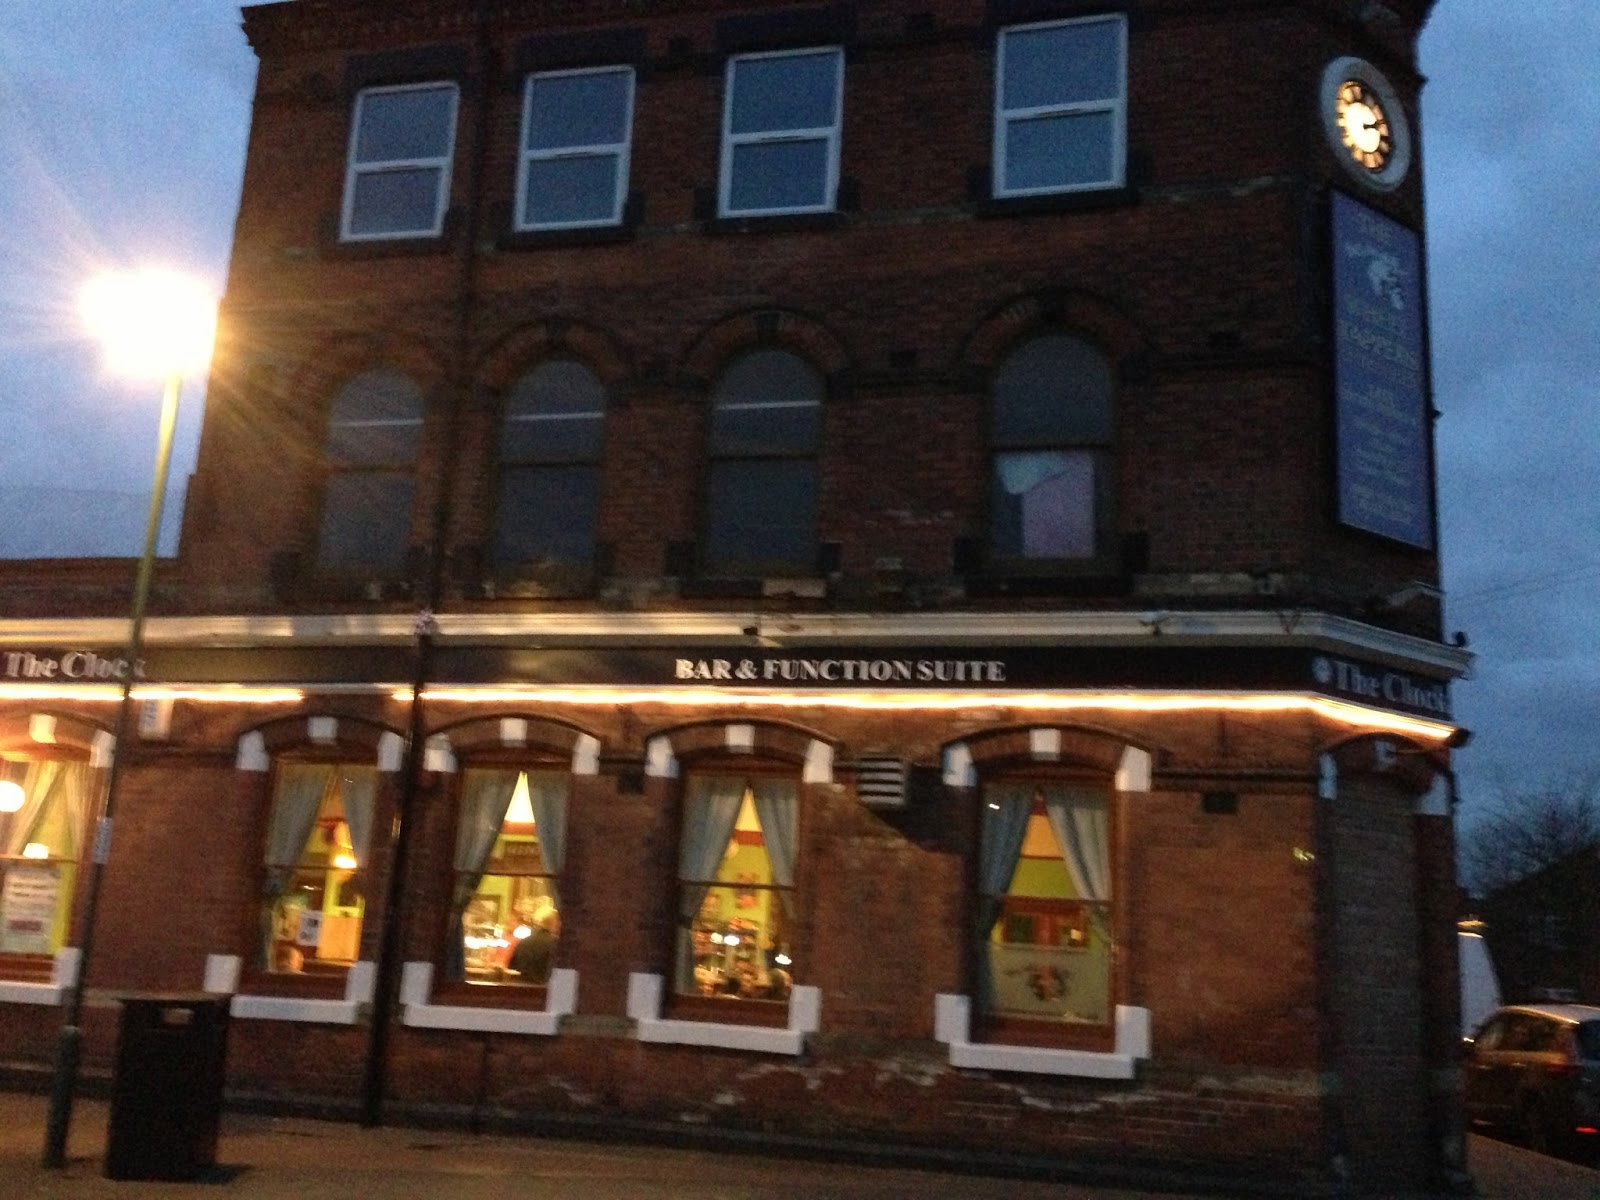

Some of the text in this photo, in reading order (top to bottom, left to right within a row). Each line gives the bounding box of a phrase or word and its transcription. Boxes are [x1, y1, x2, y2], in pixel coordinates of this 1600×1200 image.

[5, 651, 58, 677] The
[674, 658, 1006, 682] BAR & FUNCTION SUITE
